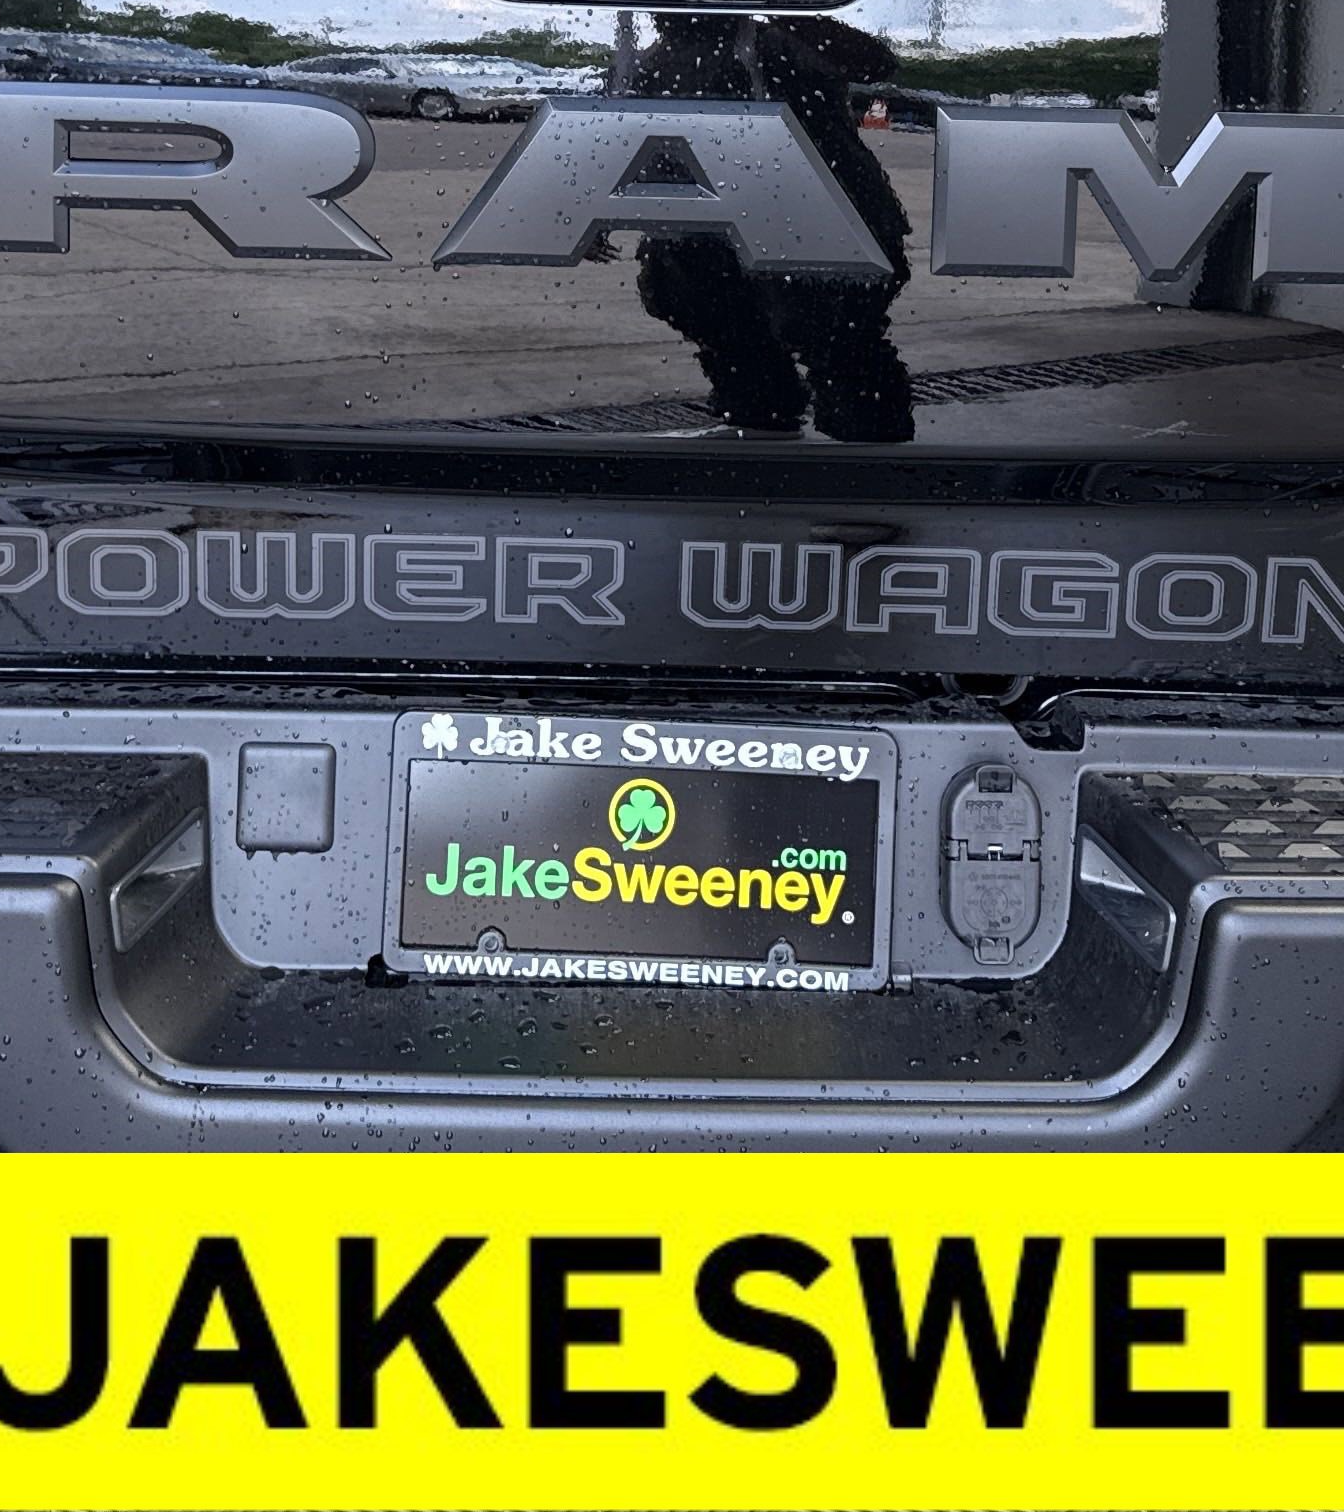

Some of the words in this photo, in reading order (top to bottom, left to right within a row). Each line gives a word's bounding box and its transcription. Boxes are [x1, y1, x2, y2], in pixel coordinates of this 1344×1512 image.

[469, 716, 602, 763] Jake
[620, 722, 870, 782] Sweeney
[771, 845, 847, 872] .com
[423, 952, 850, 992] WWW.JAKESWEENEY.COM
